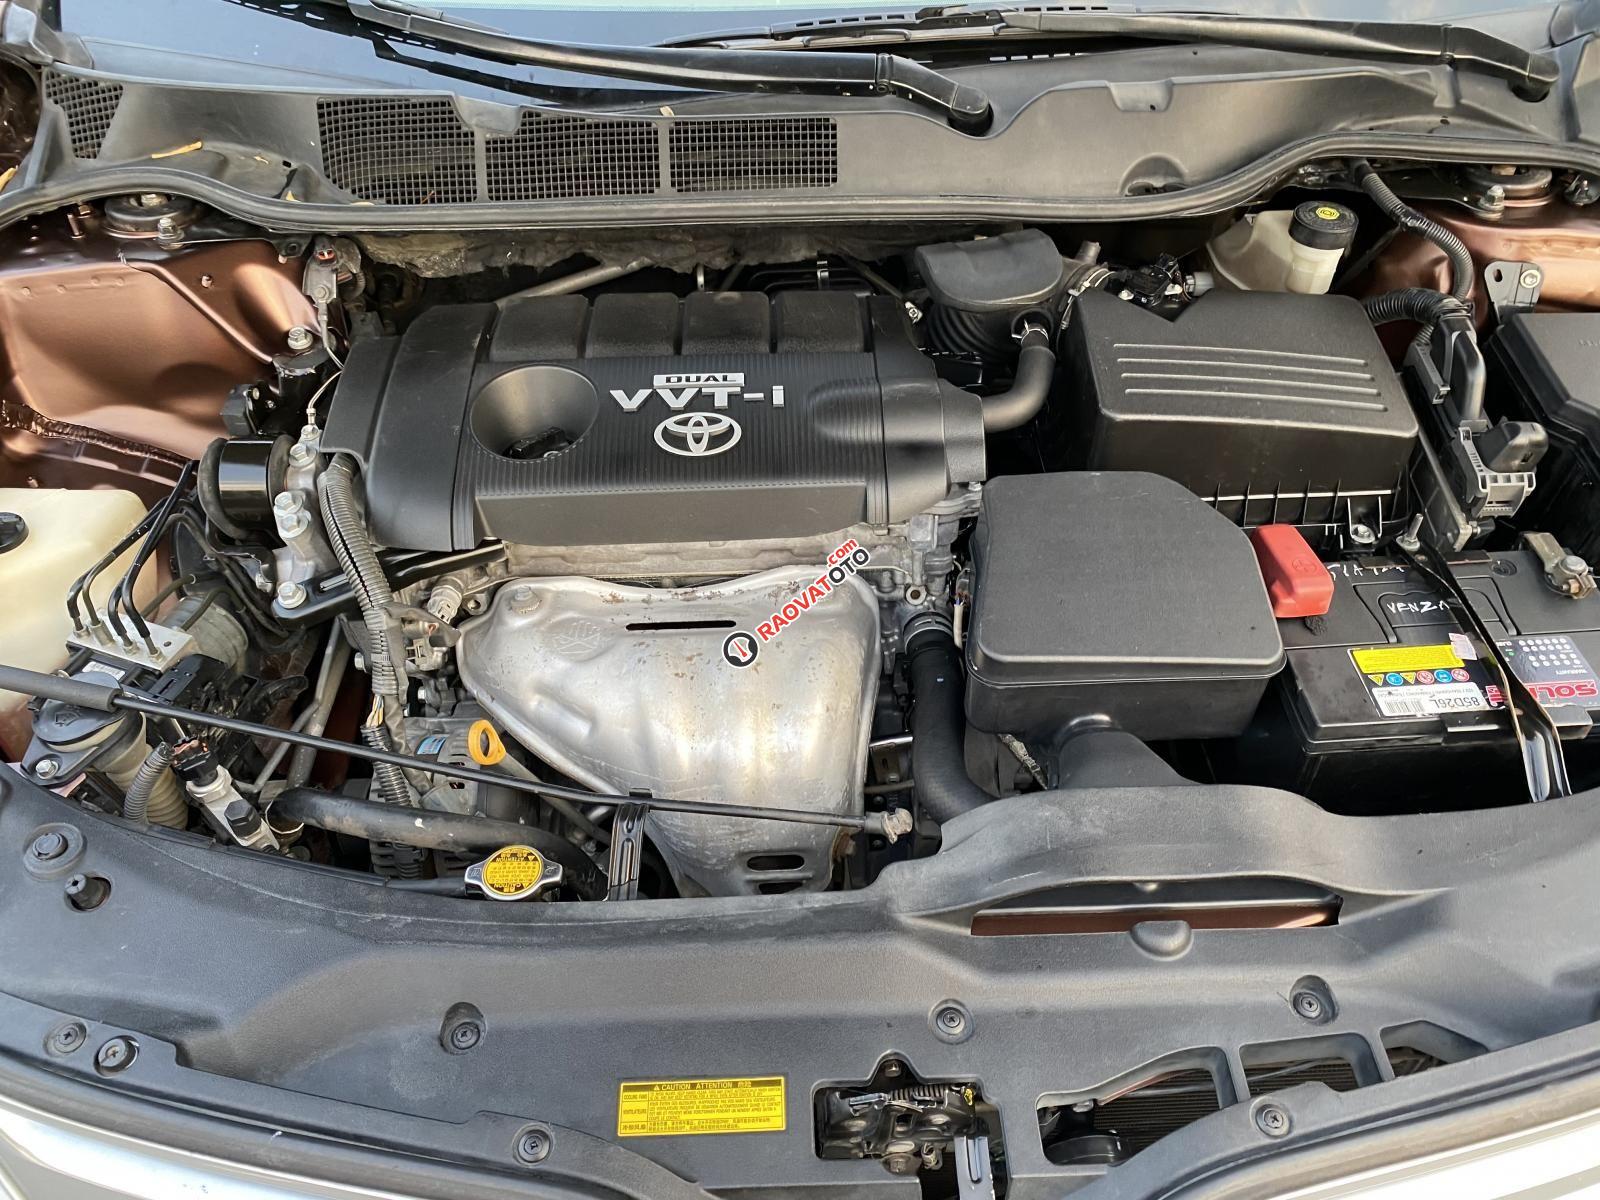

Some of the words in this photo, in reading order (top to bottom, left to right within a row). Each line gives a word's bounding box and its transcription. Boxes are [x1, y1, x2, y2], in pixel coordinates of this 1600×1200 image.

[665, 374, 737, 384] DUAL
[1430, 696, 1480, 709] 85D26L
[661, 1083, 691, 1091] CAUTION
[696, 1081, 733, 1090] ATTENTION
